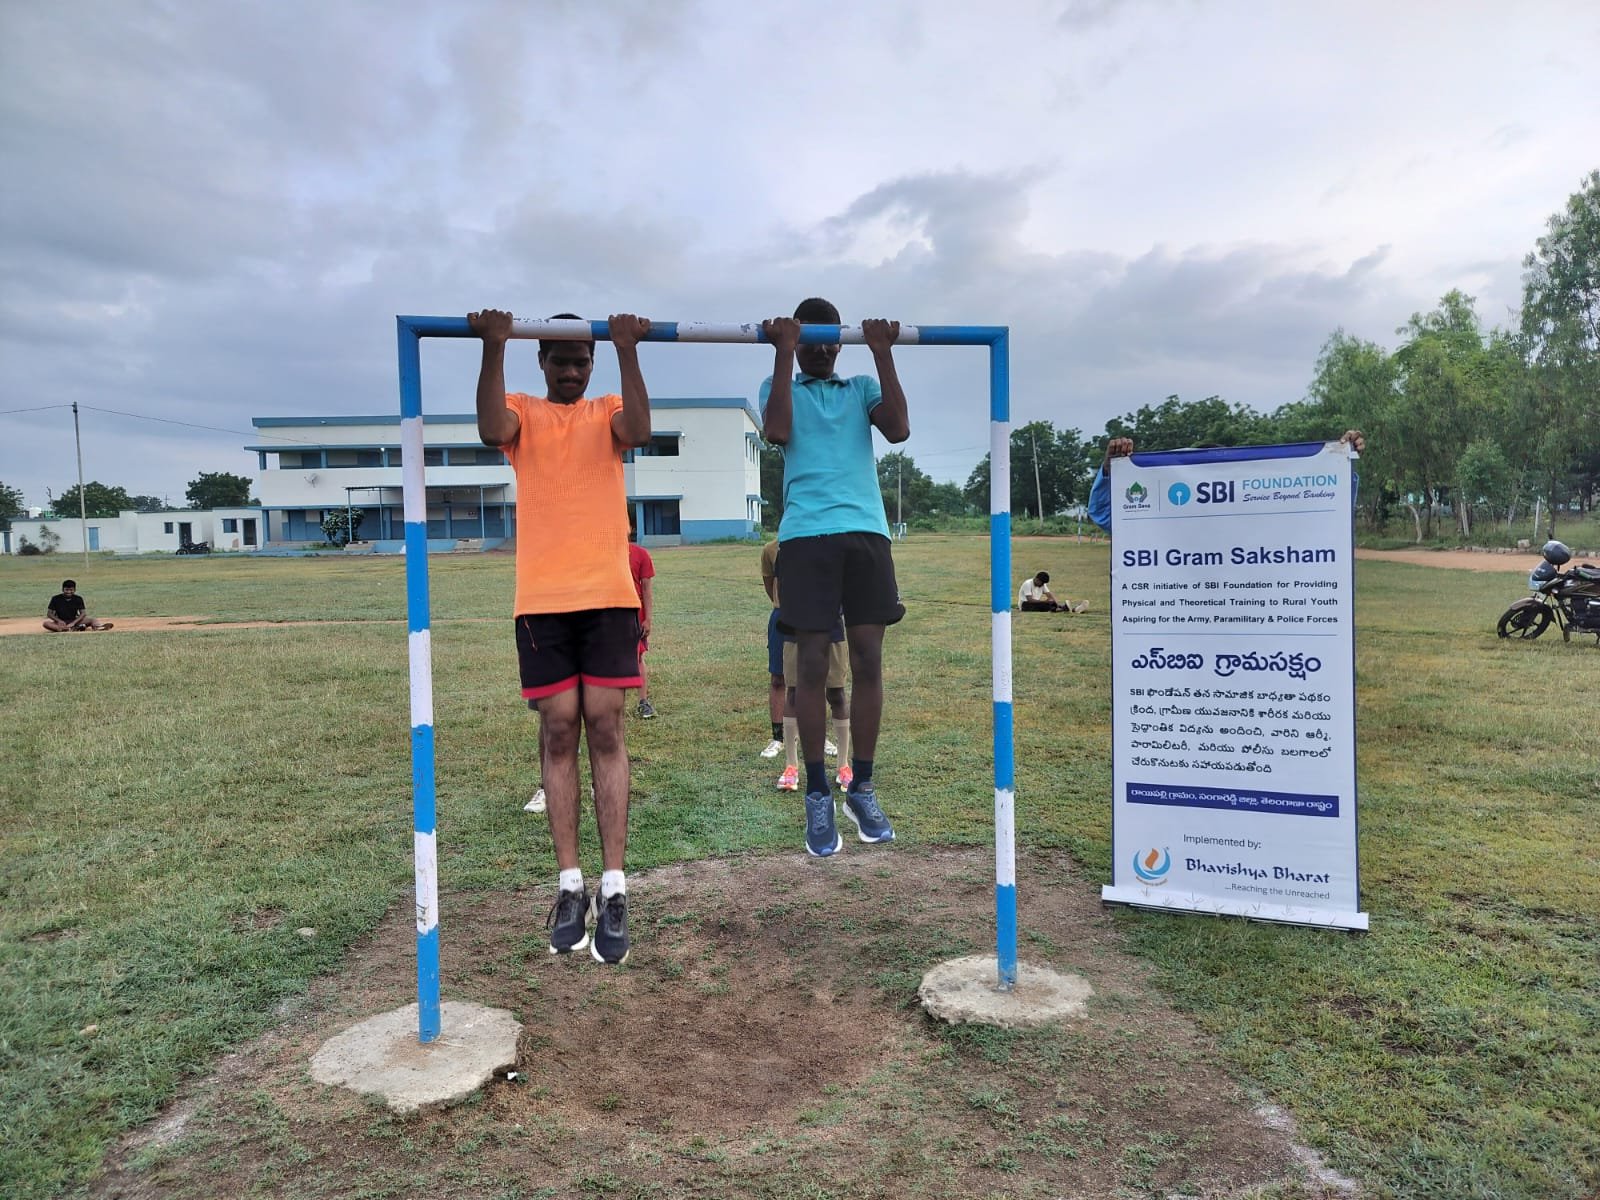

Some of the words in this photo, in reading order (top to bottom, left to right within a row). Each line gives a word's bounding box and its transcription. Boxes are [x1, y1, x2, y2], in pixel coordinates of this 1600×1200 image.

[1242, 474, 1337, 490] FOUNDATION
[1196, 480, 1235, 503] SBI
[1242, 493, 1270, 502] Service
[1273, 492, 1301, 500] Beyond
[1303, 490, 1335, 500] Banking
[1123, 549, 1158, 567] SBI
[1166, 549, 1223, 566] Gram
[1231, 546, 1336, 564] Saksham
[1153, 582, 1188, 590] initiative
[1193, 582, 1201, 590] of
[1204, 582, 1220, 590] SBI
[1294, 580, 1338, 590] Providing
[1122, 599, 1156, 607] Physical
[1179, 598, 1226, 606] Theoretical
[1230, 598, 1266, 607] Training
[1282, 598, 1307, 606] Rural
[1311, 598, 1338, 606] Youth
[1122, 615, 1156, 625] Aspiring
[1158, 615, 1170, 623] for
[1172, 615, 1186, 623] the
[1214, 615, 1265, 624] Paramilitary
[1277, 615, 1304, 623] Police
[1307, 615, 1338, 623] Forces
[1214, 650, 1322, 681] గ్రామసక్షం
[1129, 688, 1145, 696] SBI
[1193, 689, 1211, 699] తన
[1212, 690, 1255, 699] సామాజిక
[1298, 693, 1331, 702] పథకం
[1159, 705, 1192, 715] గ్రామీణ
[1291, 710, 1331, 721] మరియు
[1179, 724, 1214, 735] విద్యను
[1270, 728, 1300, 738] వారిని
[1198, 743, 1235, 753] మరియు
[1191, 759, 1272, 774] సహాయపడుతోంది
[1183, 834, 1245, 847] Implemented
[1247, 838, 1262, 850] by:
[1185, 858, 1268, 881] Bhavishya
[1273, 866, 1330, 884] Bharat
[1269, 886, 1282, 895] the
[1284, 888, 1330, 900] Unreached
